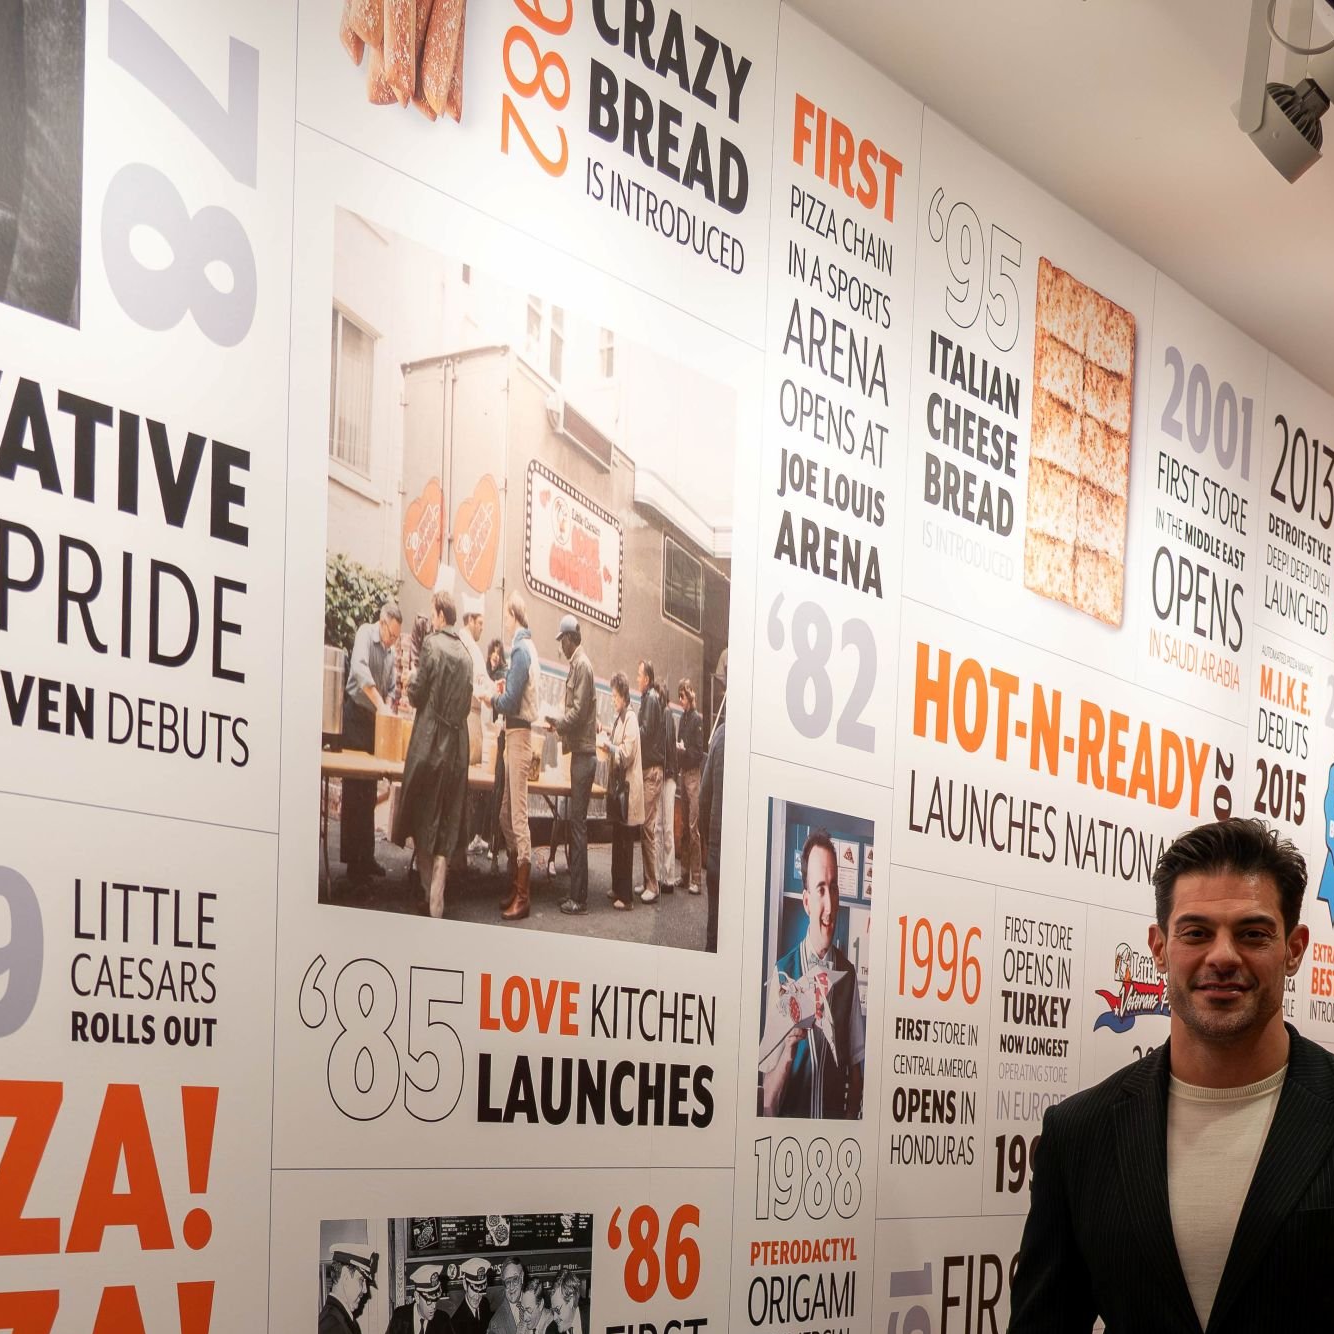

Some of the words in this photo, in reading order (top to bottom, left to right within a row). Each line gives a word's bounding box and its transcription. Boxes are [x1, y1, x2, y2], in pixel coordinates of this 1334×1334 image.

[591, 0, 753, 124] CRAZY
[588, 58, 749, 215] BREAD
[792, 92, 903, 223] FIRST
[610, 169, 745, 275] INTRODUCED
[791, 184, 838, 244] PIZZA
[842, 218, 893, 276] CHAIN
[827, 264, 891, 329] SPORTS
[783, 298, 889, 407] ARENA
[929, 330, 1020, 419] ITALIAN
[780, 379, 856, 455] OPENS
[927, 393, 1017, 478] CHEESE
[1161, 346, 1253, 481] 2001
[777, 447, 817, 499] JOE
[823, 467, 885, 527] LOUIS
[924, 451, 1014, 537] BREAD
[774, 510, 883, 599] ARENA
[1266, 544, 1288, 574] DEEP!
[1290, 556, 1311, 587] DEEP!
[1268, 512, 1332, 566] DETROIT-STYLE
[1152, 546, 1244, 652] OPENS
[1164, 636, 1195, 676] SAUDI
[1196, 648, 1240, 692] ARABIA
[108, 692, 250, 767] DEBUTS
[913, 641, 1210, 817] HOT-N-READY
[1258, 707, 1308, 760] DEBUTS
[908, 770, 1057, 863] LAUNCHES
[1065, 811, 1174, 885] NATION
[1254, 758, 1307, 826] 2015
[74, 878, 218, 950] LITTLE
[70, 954, 218, 1005] CAESARS
[898, 915, 982, 1006] 1996
[1003, 948, 1053, 988] OPENS
[71, 1010, 157, 1045] ROLLS
[163, 1016, 218, 1048] OUT
[480, 973, 580, 1036] LOVE
[591, 984, 716, 1046] KITCHEN
[1001, 990, 1071, 1029] TURKEY
[1026, 1035, 1069, 1058] LONGEST
[477, 1053, 714, 1128] LAUNCHES
[892, 1086, 956, 1124] OPENS
[998, 1062, 1042, 1082] OPERATING
[754, 1136, 862, 1221] 1988
[890, 1134, 974, 1166] HONDURAS
[750, 1237, 857, 1266] PTERODACTYL
[747, 1271, 856, 1326] ORIGAMI
